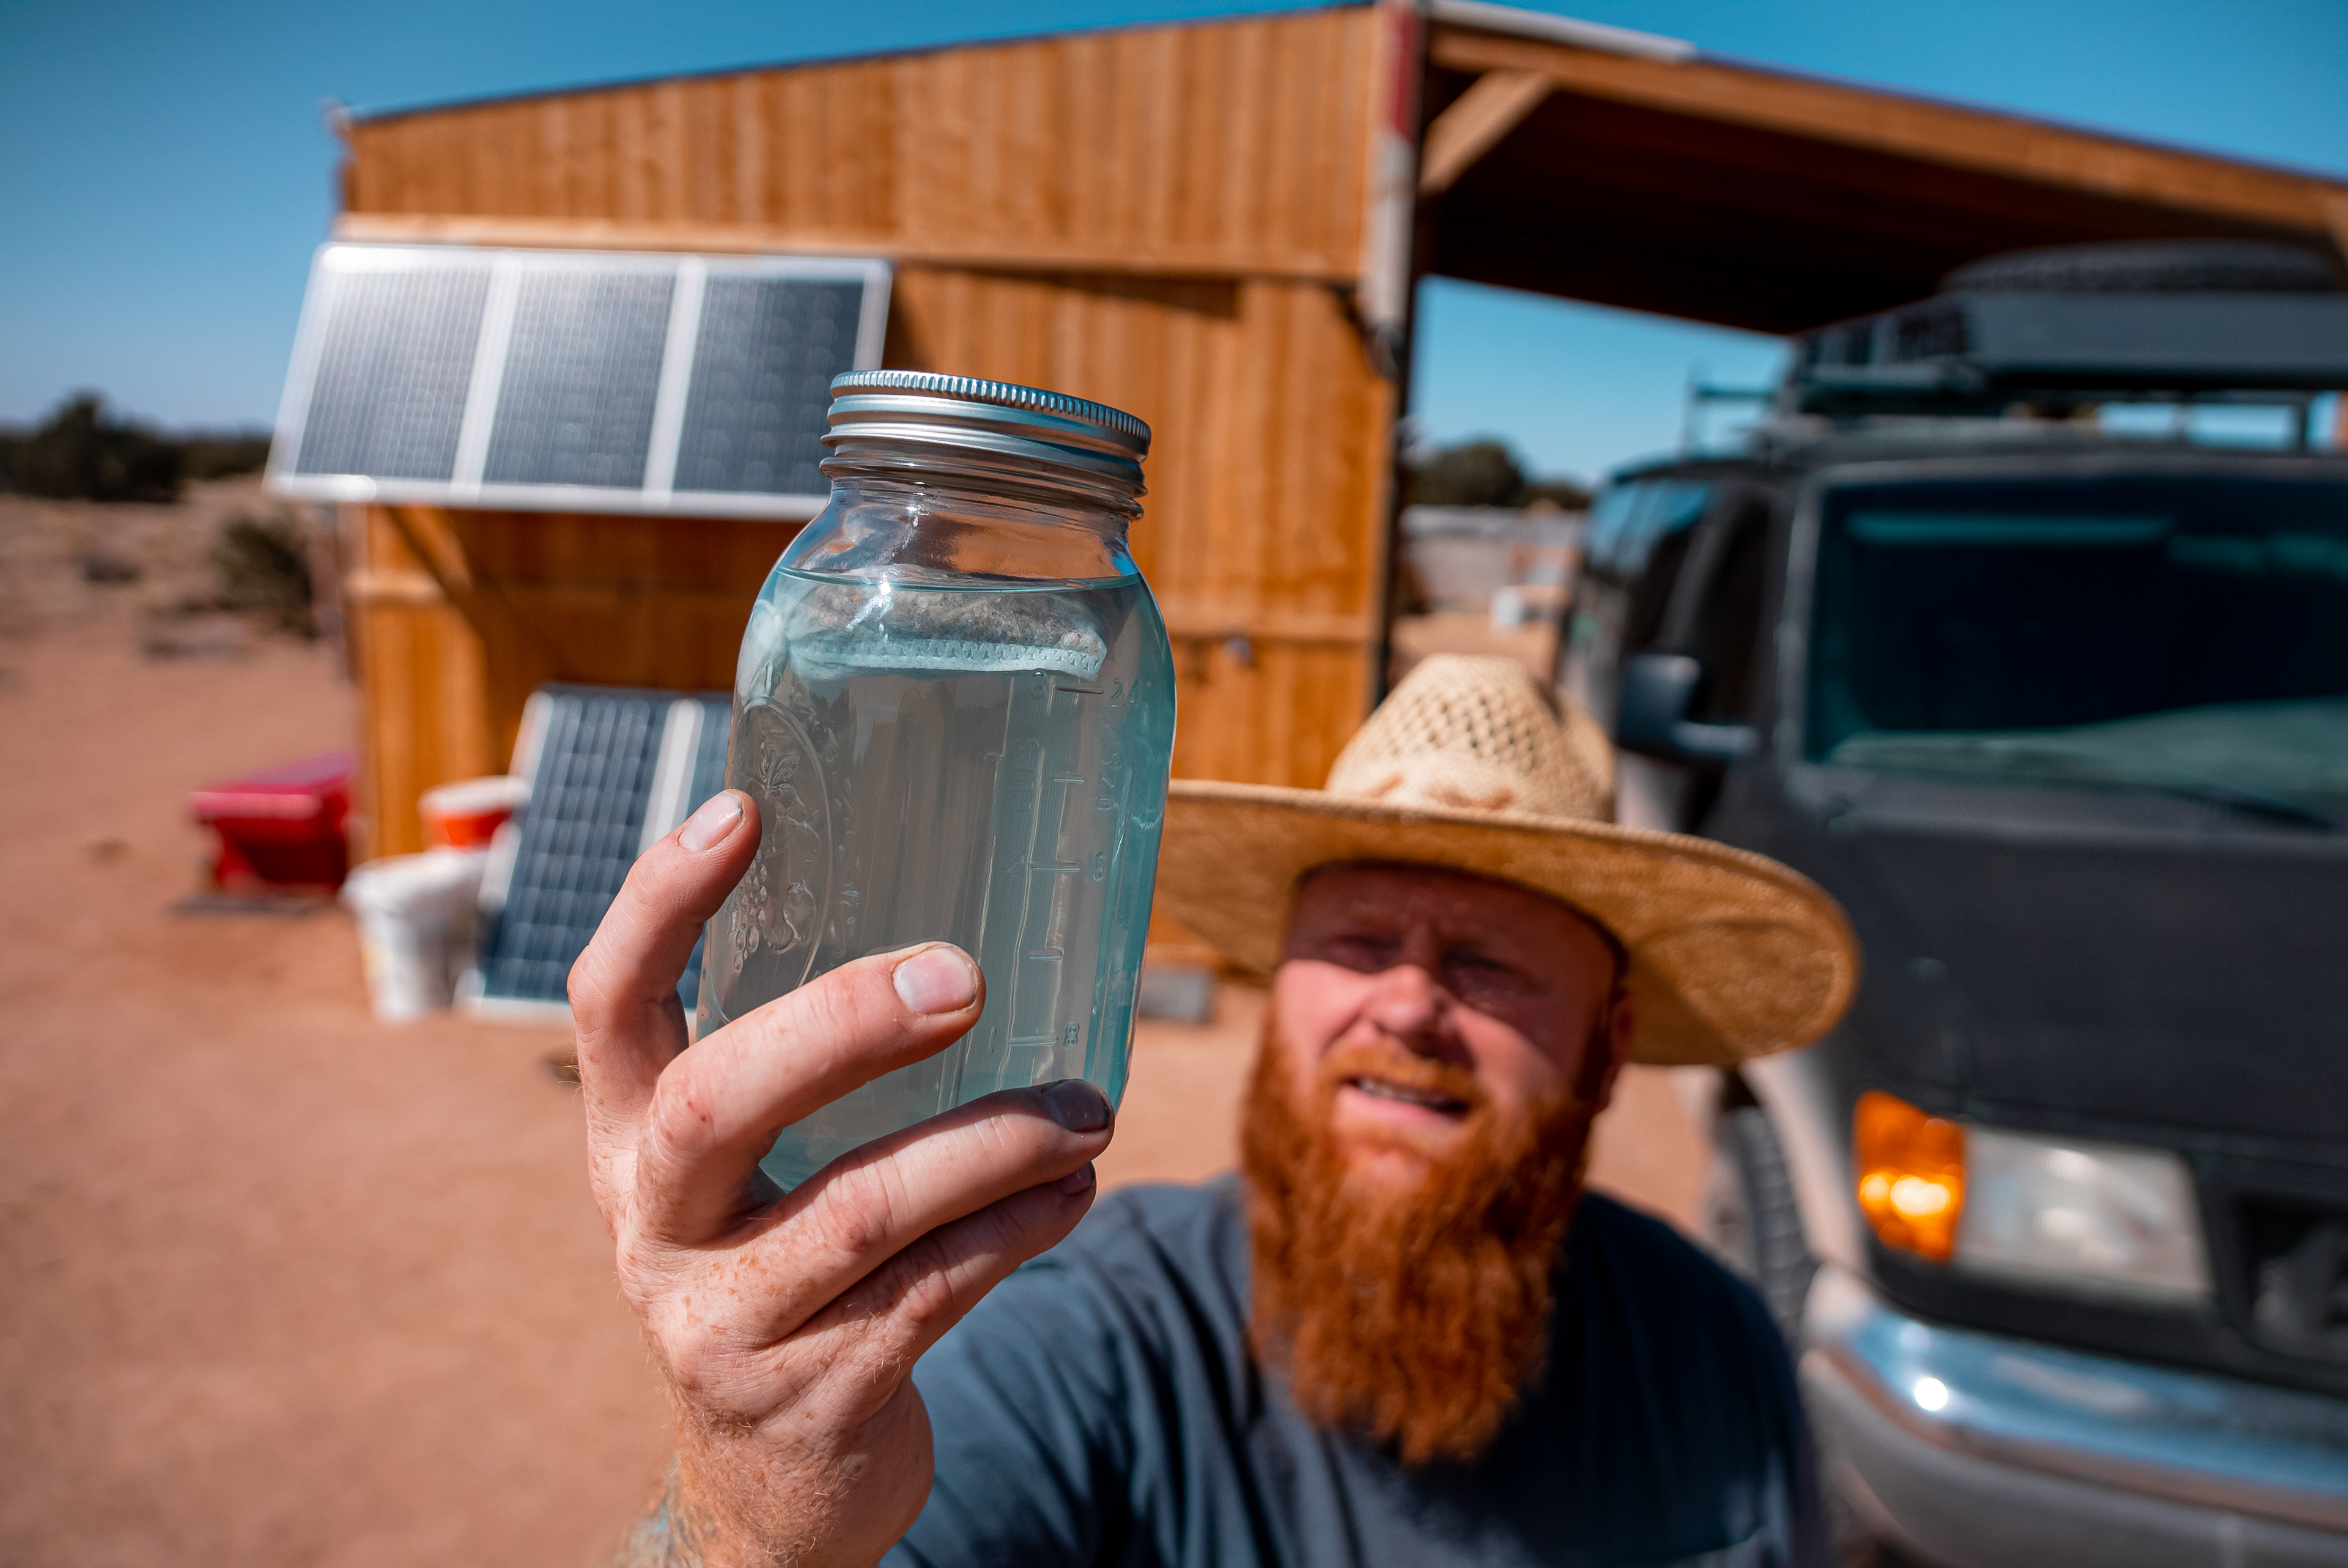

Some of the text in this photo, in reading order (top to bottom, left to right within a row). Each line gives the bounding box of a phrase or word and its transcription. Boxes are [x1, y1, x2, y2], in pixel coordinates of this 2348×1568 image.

[1032, 668, 1047, 699] 3
[1110, 677, 1142, 709] 24
[1006, 849, 1025, 882] 2
[1084, 852, 1106, 882] 16
[1063, 1021, 1080, 1051] 8
